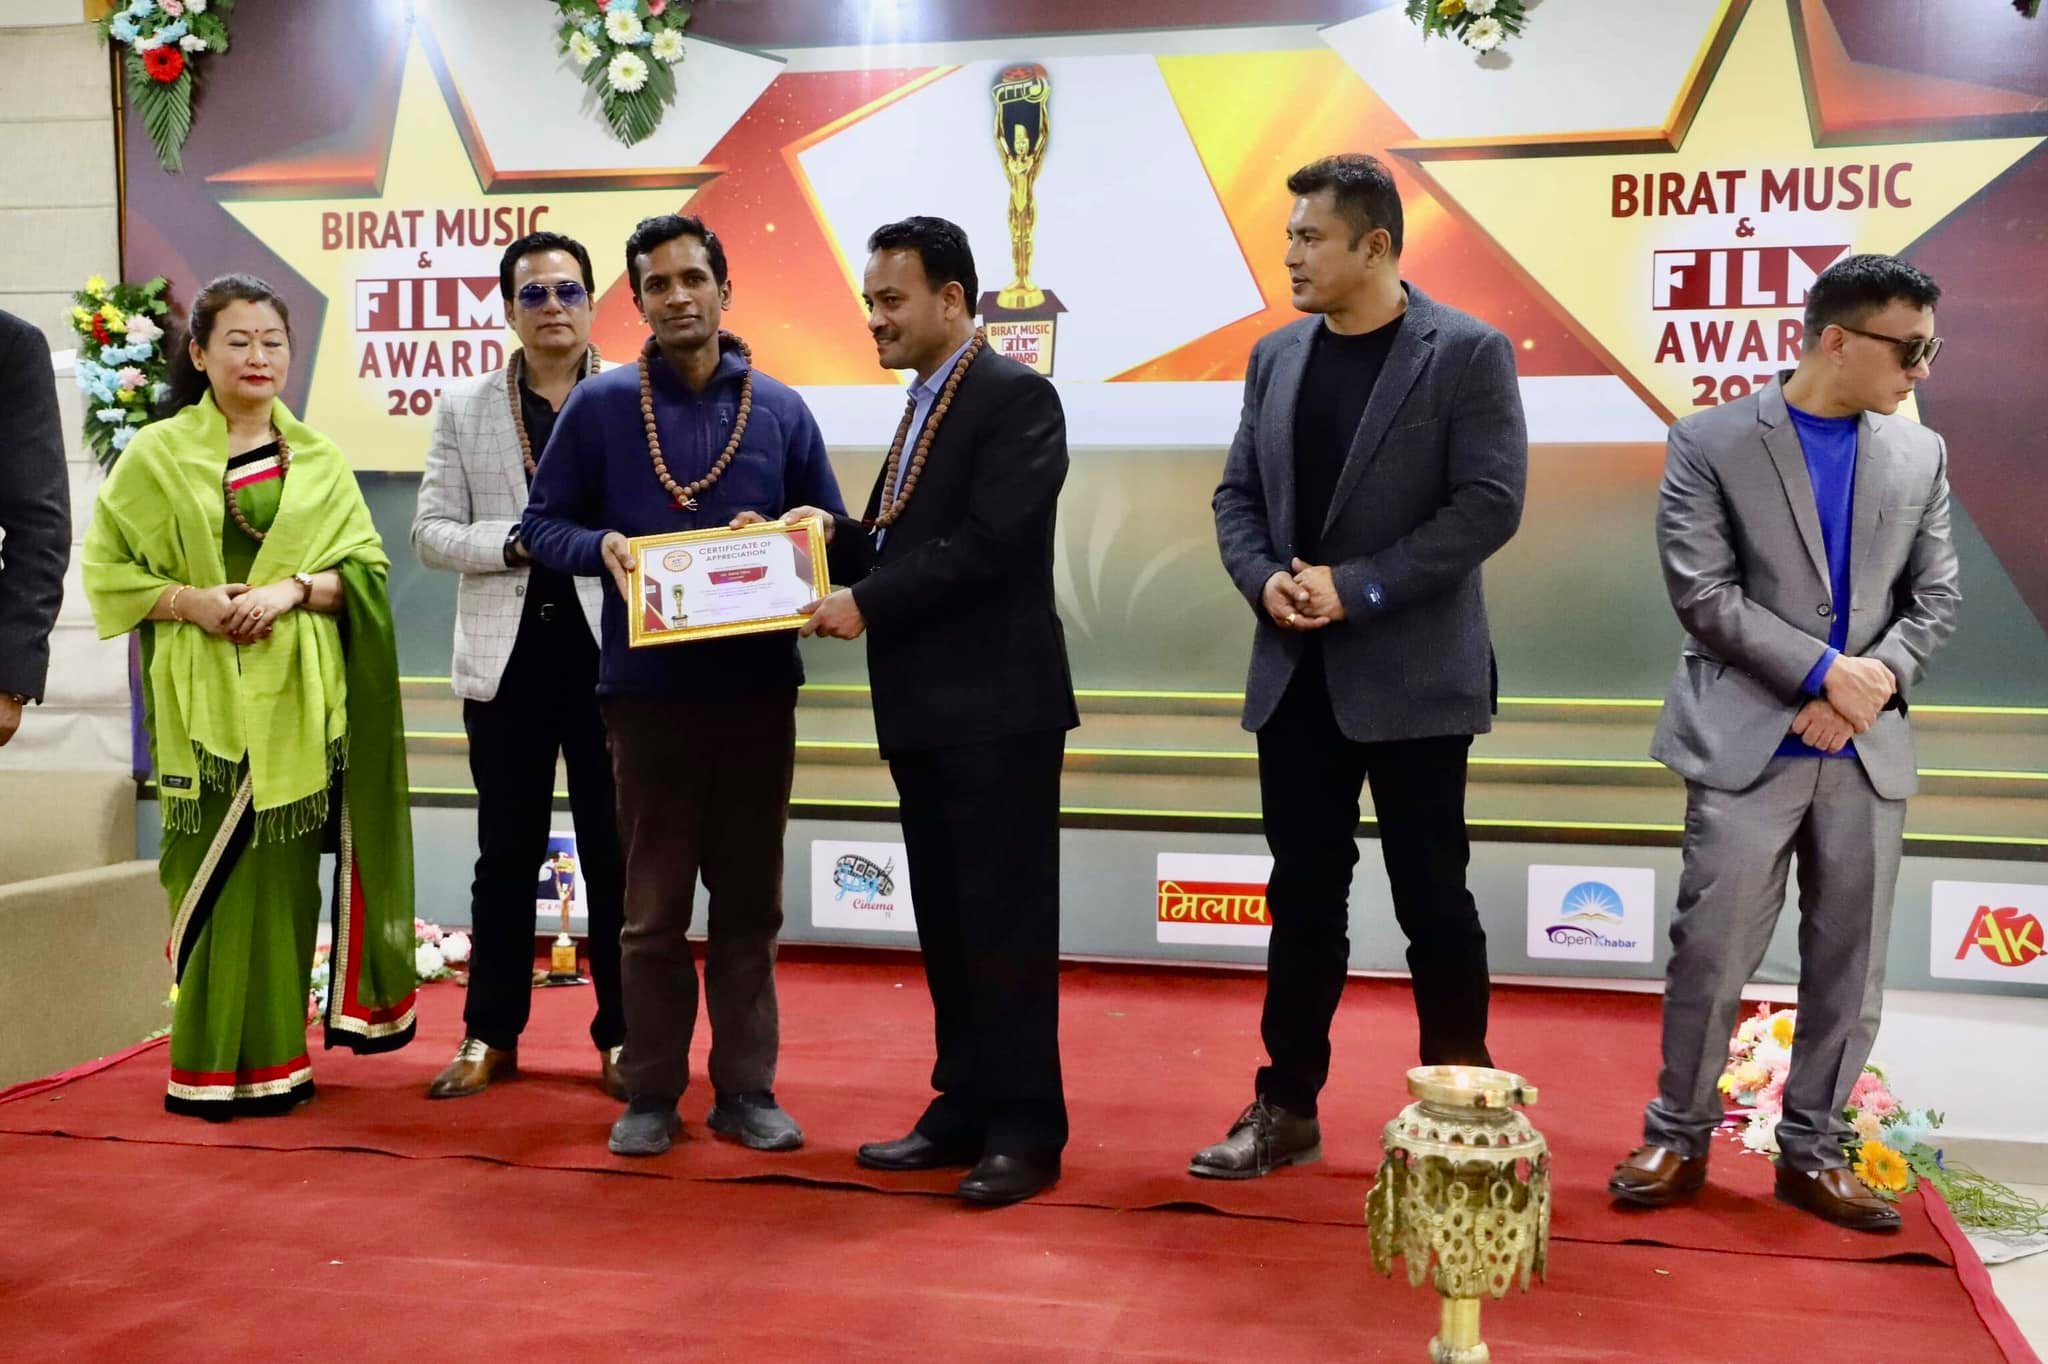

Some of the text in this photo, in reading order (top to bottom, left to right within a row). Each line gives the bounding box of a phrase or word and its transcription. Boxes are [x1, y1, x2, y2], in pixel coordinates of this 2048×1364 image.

[1611, 162, 1913, 217] BIRAT MUSIC
[322, 205, 550, 249] BIRAT MUSIC
[1735, 217, 1756, 238] &
[418, 251, 432, 269] &
[356, 278, 506, 330] FILM
[991, 324, 1049, 336] BIRAT MUSIC
[1654, 319, 1805, 363] AWAR
[1002, 338, 1039, 351] FILM
[358, 339, 505, 379] AWARD
[388, 388, 442, 416] 20
[1692, 374, 1775, 406] 20
[698, 540, 772, 555] CERTIFICATE OF
[705, 549, 767, 561] APPRECIATION
[853, 898, 895, 911] Cinema
[1158, 881, 1267, 923] मिलाप
[1554, 931, 1593, 948] Open
